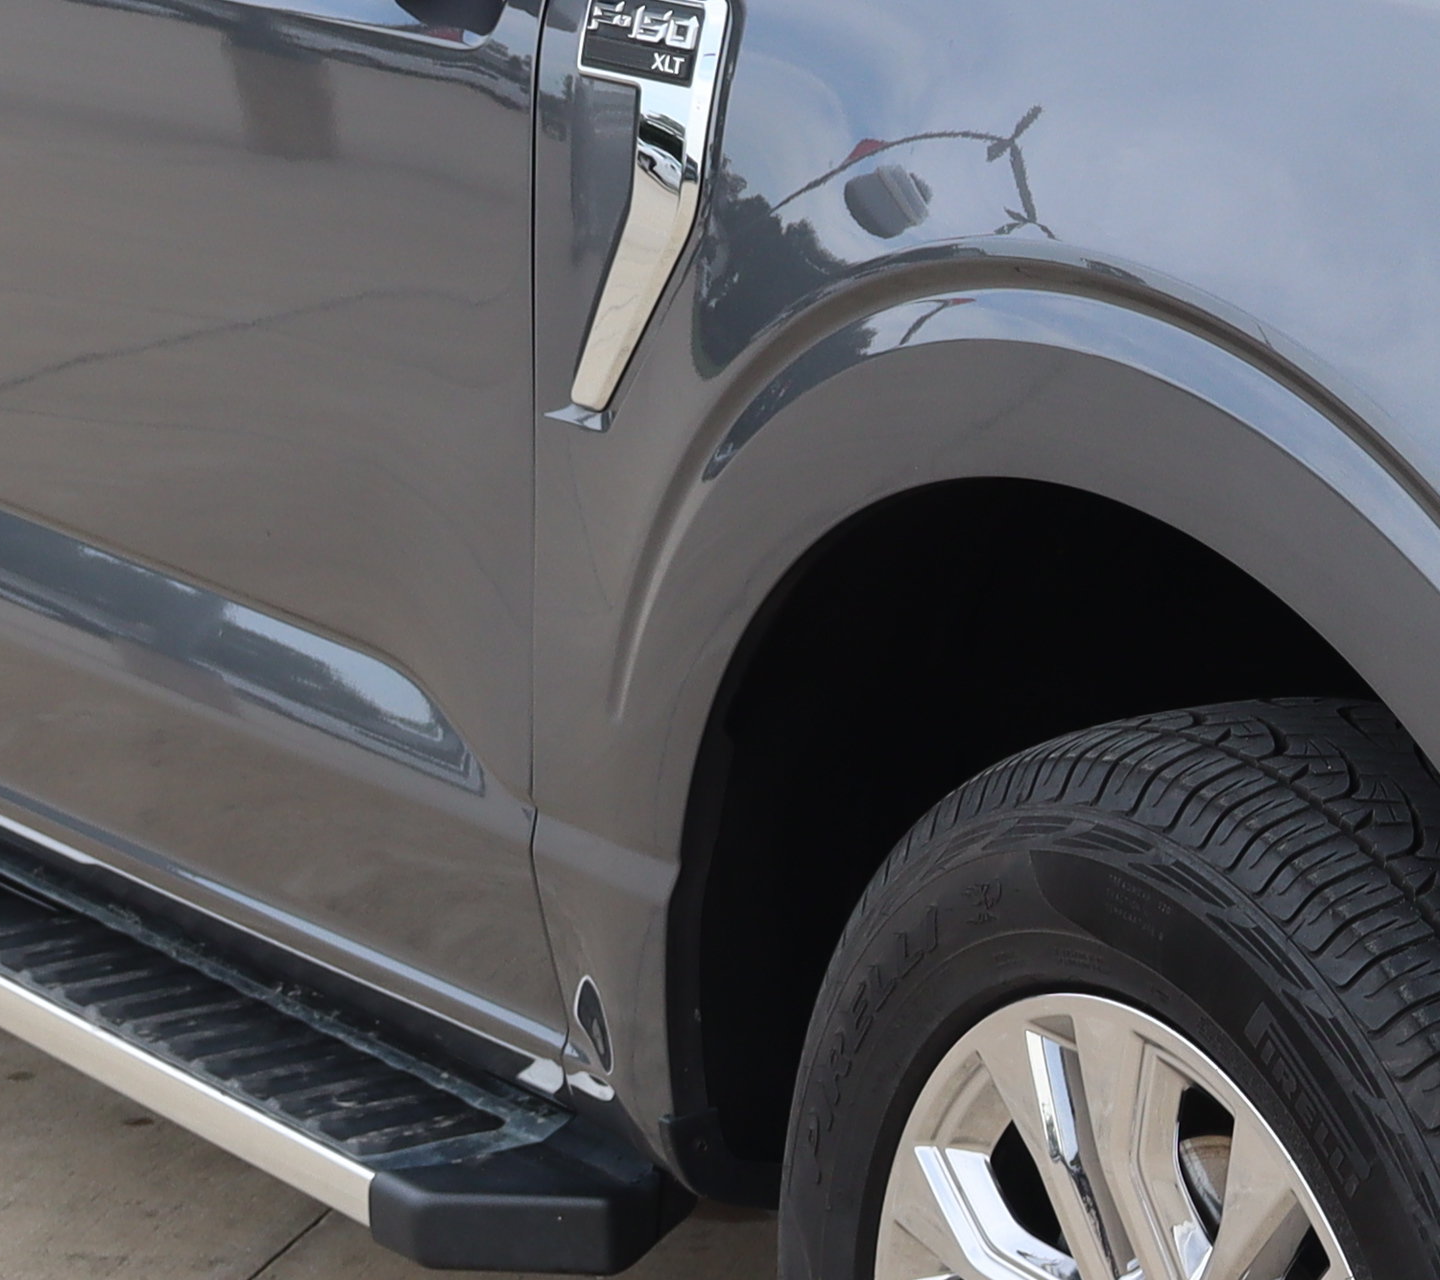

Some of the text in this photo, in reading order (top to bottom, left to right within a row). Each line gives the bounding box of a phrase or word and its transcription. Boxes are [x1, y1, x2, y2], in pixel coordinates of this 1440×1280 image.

[587, 0, 700, 50] F-150
[651, 52, 686, 75] XLT
[808, 904, 939, 1186] PIRELLI
[1243, 1001, 1371, 1200] PIRELLI
